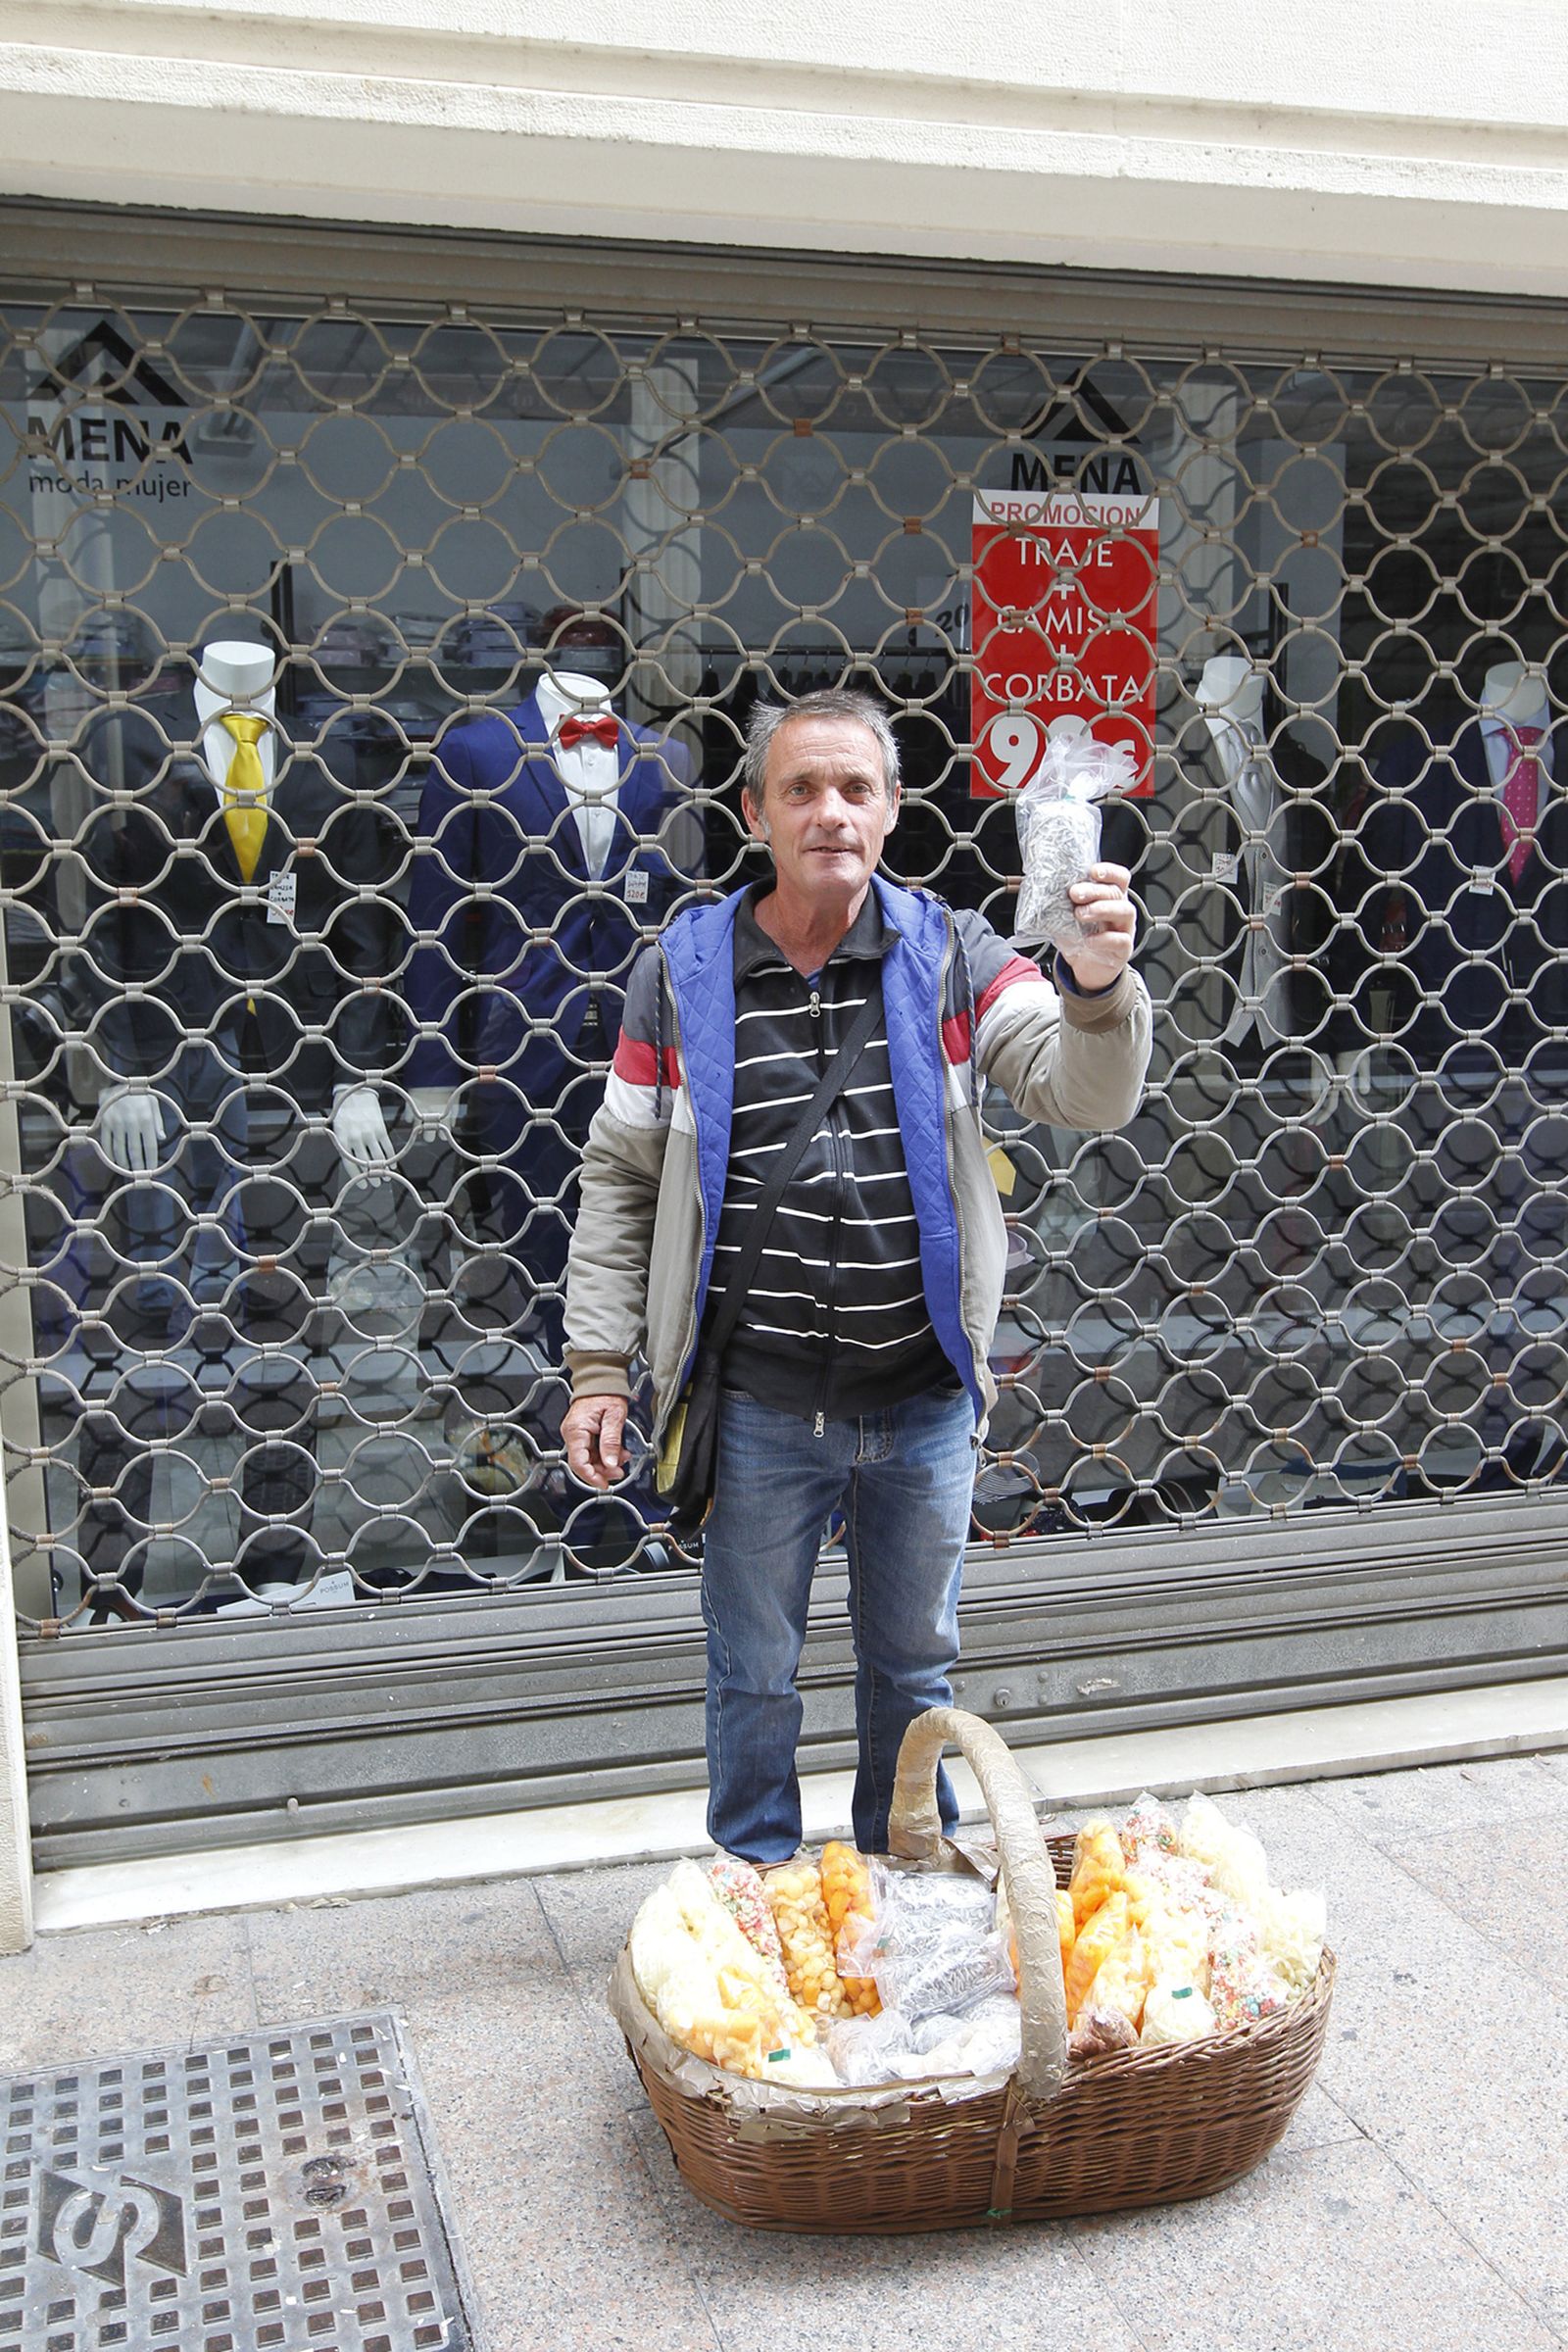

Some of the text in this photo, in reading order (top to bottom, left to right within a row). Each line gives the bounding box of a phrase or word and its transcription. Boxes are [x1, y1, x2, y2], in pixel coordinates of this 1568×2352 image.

[26, 416, 193, 465] MENA
[28, 470, 192, 503] moda mujer
[1010, 453, 1143, 495] MENA
[991, 502, 1141, 526] PROMOCION
[1015, 537, 1114, 567] TRAJE
[984, 673, 1145, 703] CORBATA
[319, 1581, 349, 1593] POSSUM
